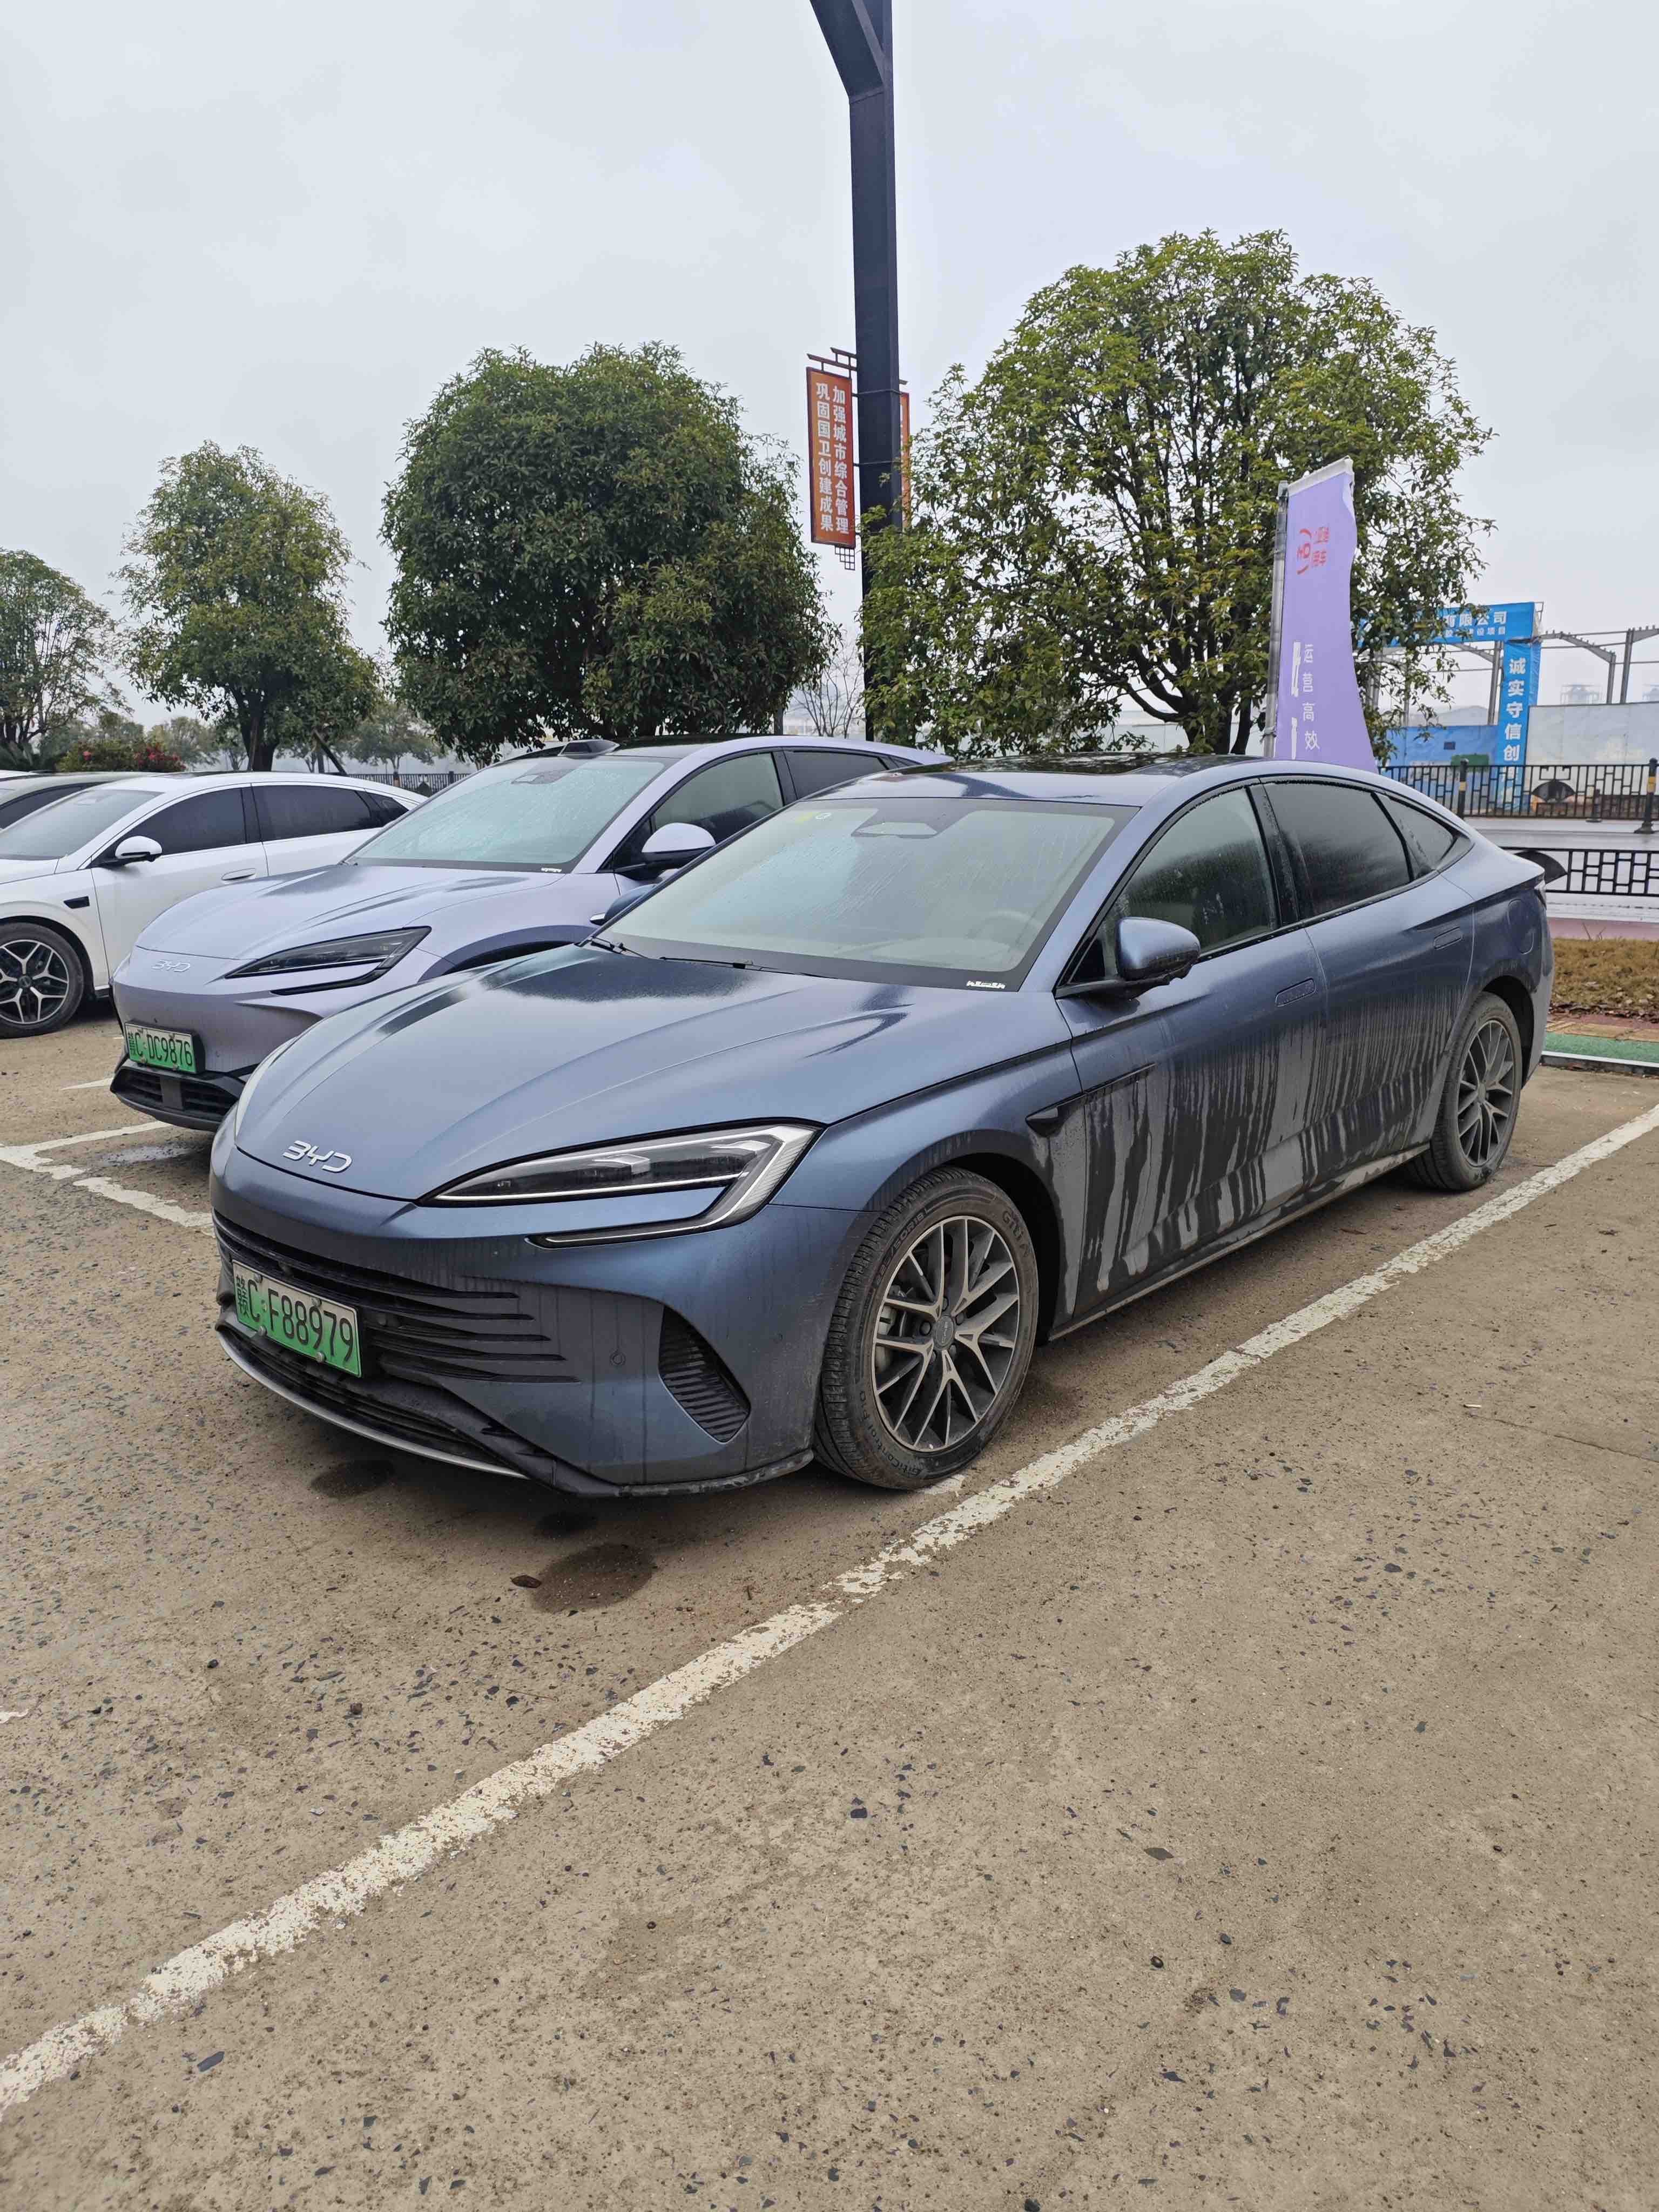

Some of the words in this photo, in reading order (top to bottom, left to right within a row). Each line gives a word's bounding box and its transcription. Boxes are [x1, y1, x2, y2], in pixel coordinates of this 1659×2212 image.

[816, 382, 833, 531] 巩固国卫创建成果
[832, 386, 849, 534] 加强城市综合管理
[1302, 643, 1320, 750] 运营高效
[1501, 658, 1526, 801] 诚实守信创
[151, 959, 191, 973] BYD
[282, 1140, 353, 1173] BYD
